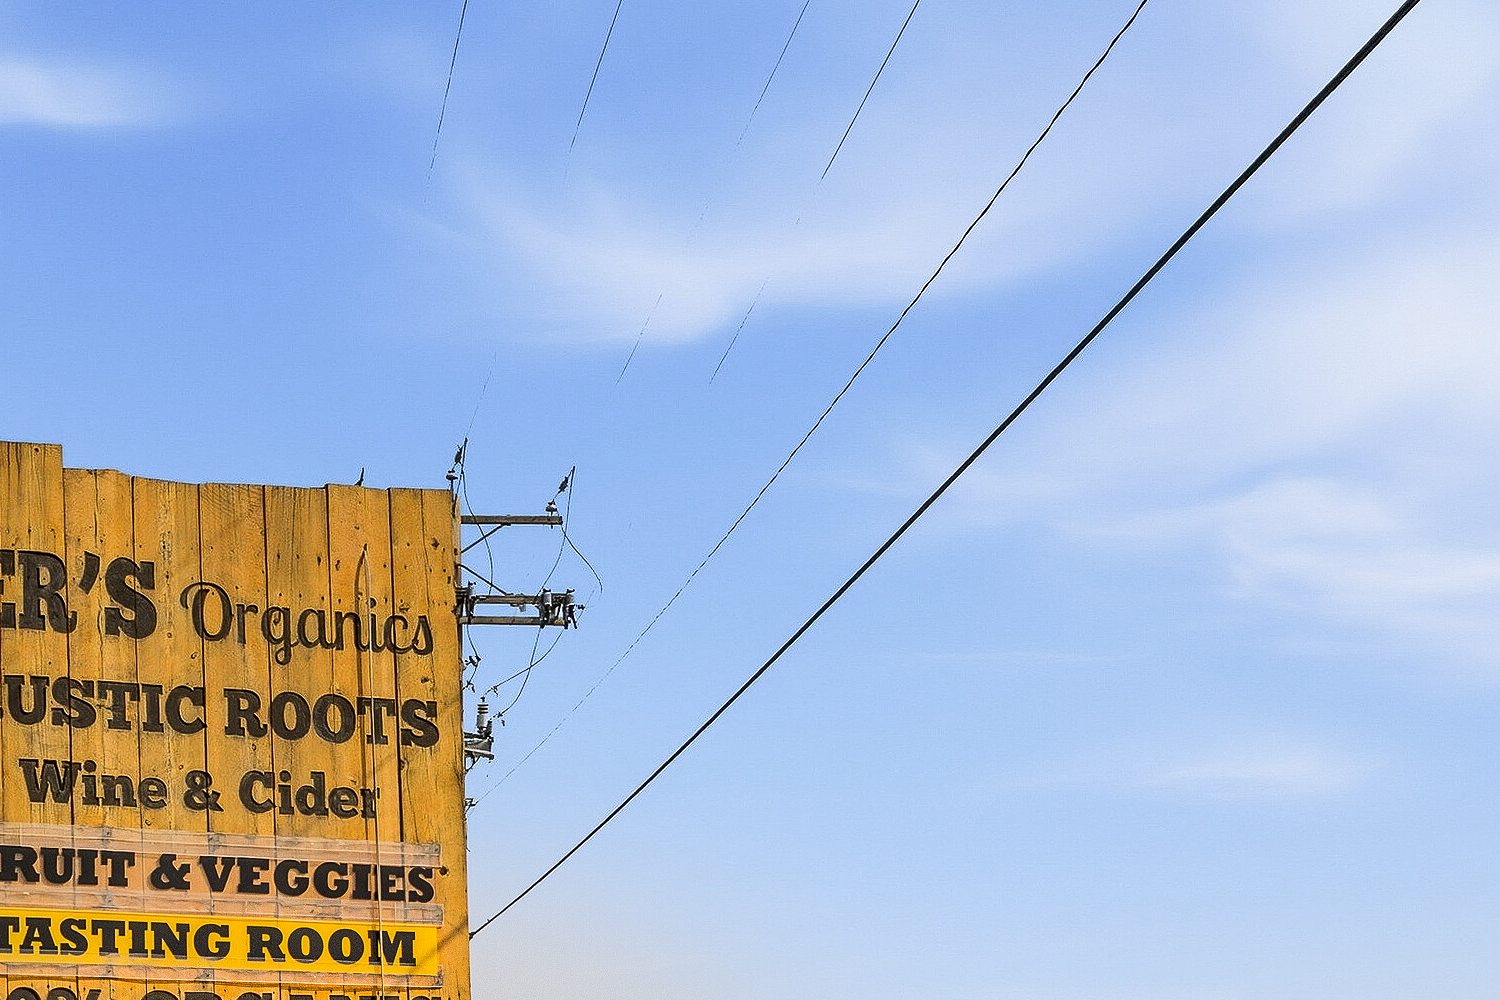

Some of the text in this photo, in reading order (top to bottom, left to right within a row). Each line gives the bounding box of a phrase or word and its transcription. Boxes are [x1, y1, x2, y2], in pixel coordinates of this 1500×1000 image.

[179, 581, 435, 666] Organics
[223, 687, 440, 748] ROOTS
[18, 758, 381, 820] Wine & Cider
[150, 853, 192, 891] &
[200, 855, 436, 904] VEGGIES
[246, 925, 418, 967] ROOM
